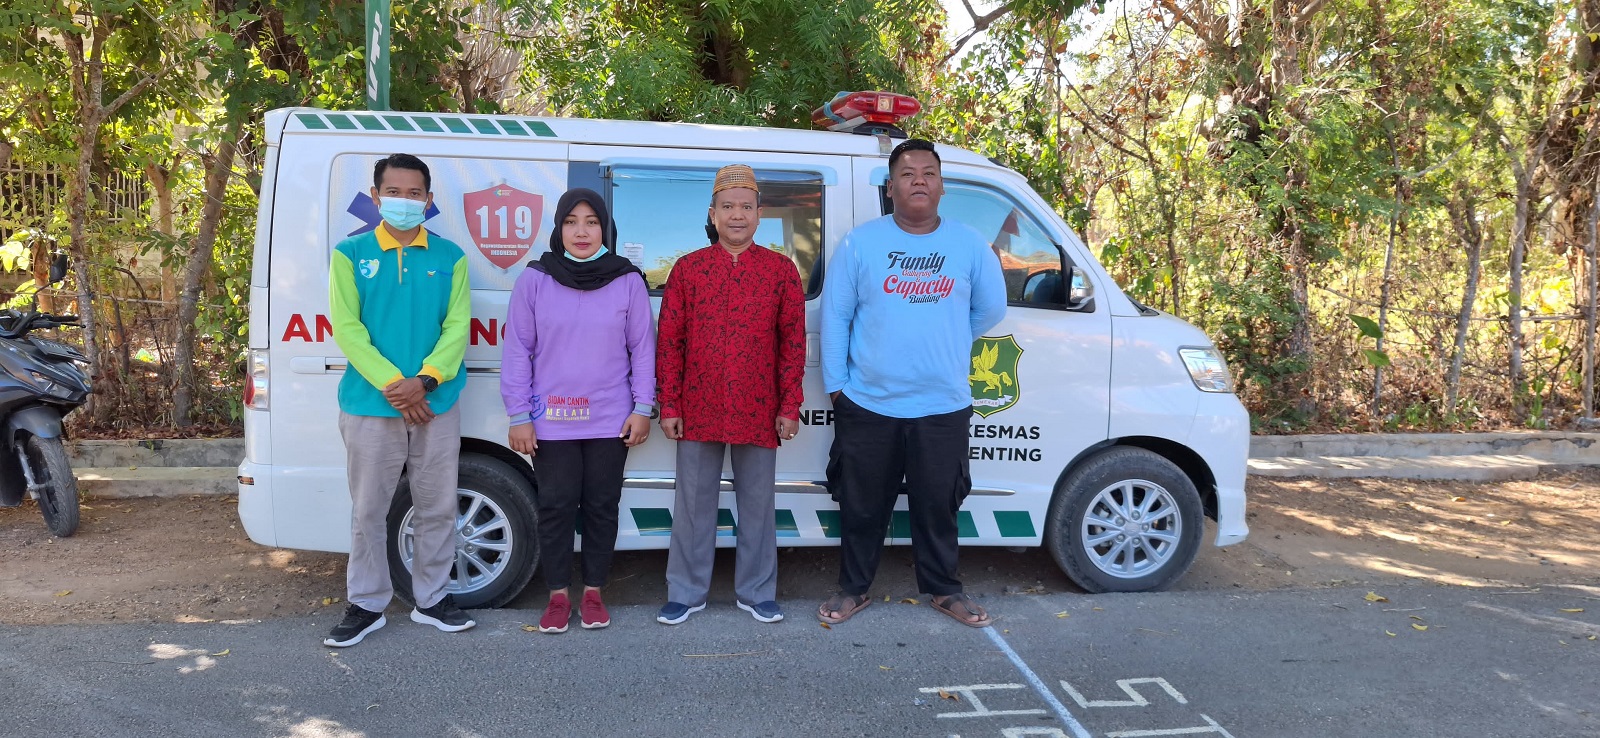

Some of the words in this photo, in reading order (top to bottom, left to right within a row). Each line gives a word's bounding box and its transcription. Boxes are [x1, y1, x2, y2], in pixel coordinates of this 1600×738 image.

[475, 205, 532, 240] 119
[887, 251, 946, 274] Family
[902, 269, 932, 278] Gathering
[883, 274, 955, 300] Capacity
[908, 294, 941, 304] Building
[547, 395, 565, 403] BIDAN
[568, 396, 589, 405] CANTIK
[546, 408, 590, 416] MELATI
[969, 424, 1040, 440] KESMAS
[969, 446, 1042, 462] ENTING
